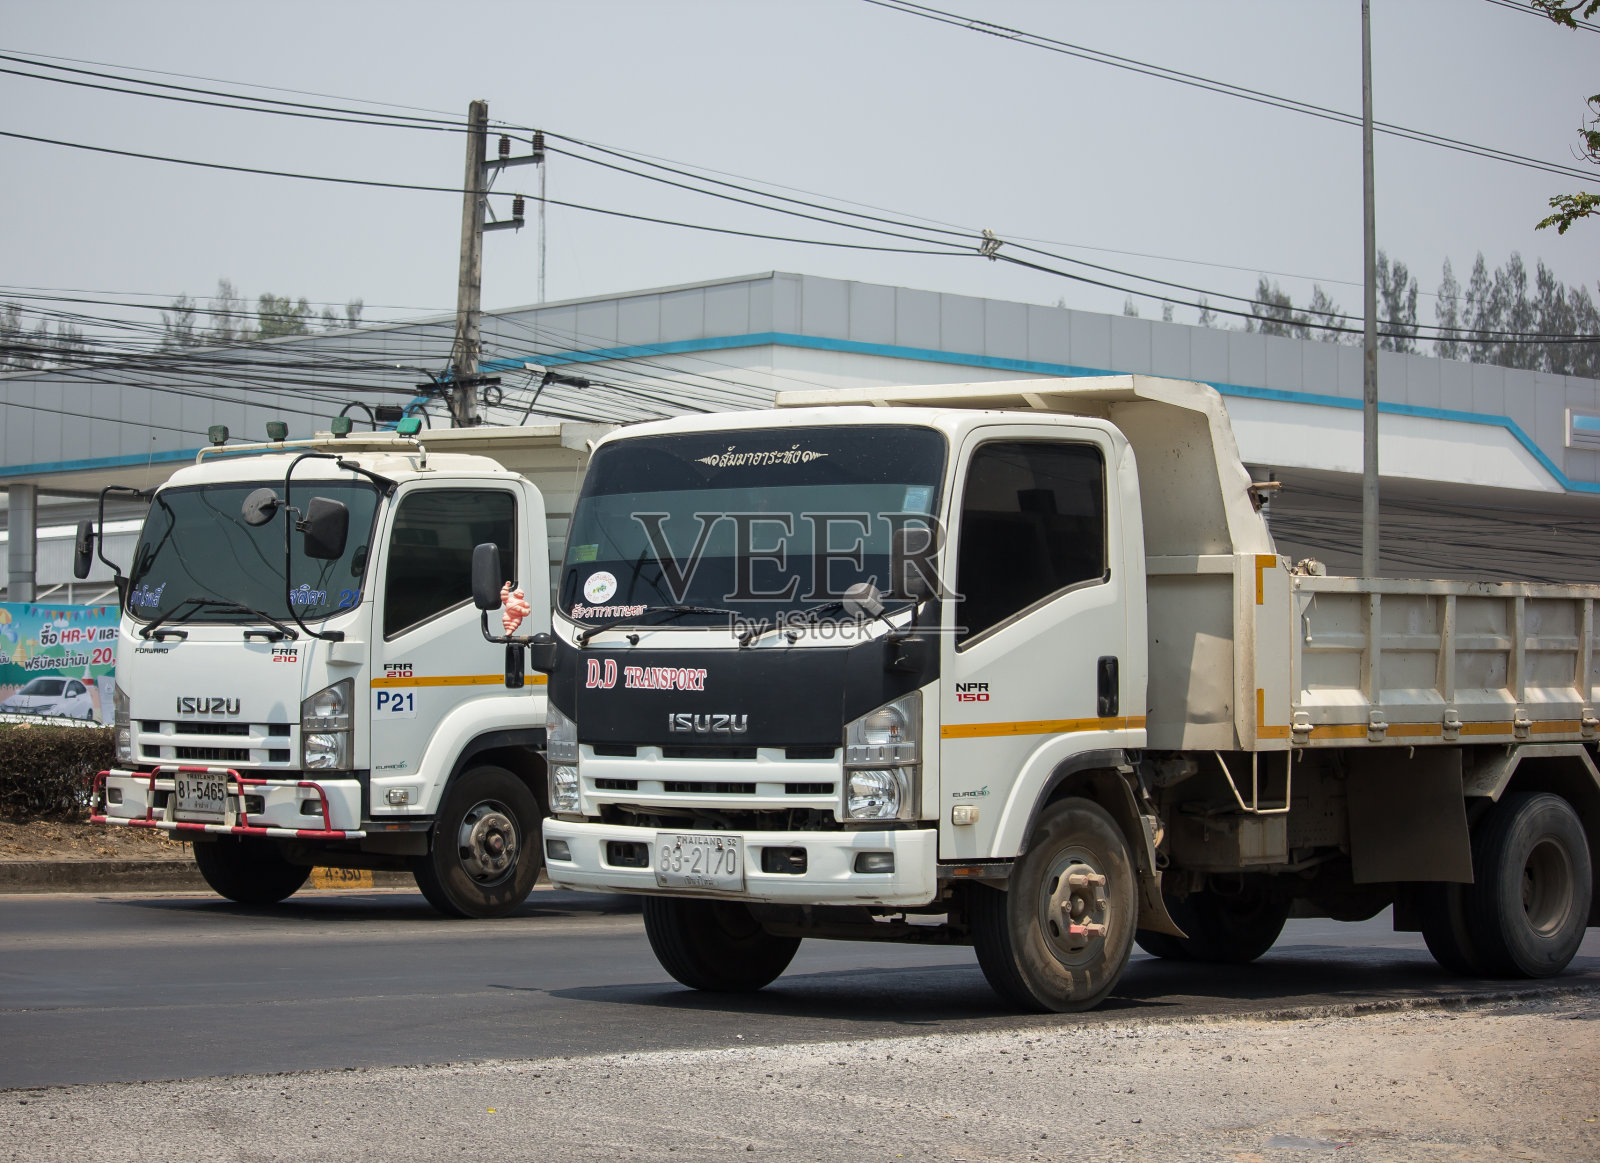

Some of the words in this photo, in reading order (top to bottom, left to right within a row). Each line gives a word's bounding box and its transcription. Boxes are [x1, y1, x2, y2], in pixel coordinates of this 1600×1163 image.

[340, 589, 361, 608] 21
[41, 624, 58, 646] ซื้อ
[60, 628, 96, 643] HR-V
[25, 651, 89, 670] ฟรีบัตรน้ำมัน
[271, 648, 298, 656] FRR
[384, 663, 413, 671] FRR
[586, 659, 617, 689] D.D
[624, 666, 707, 691] TRANSPORT
[956, 683, 989, 692] NPR
[176, 697, 241, 715] ISUZU
[377, 691, 413, 712] P21
[956, 693, 990, 702] 150
[668, 713, 748, 733] ISUZU
[178, 780, 225, 801] 81-5465
[677, 836, 722, 846] THAILAND
[727, 838, 737, 847] 52
[660, 845, 736, 875] 83-2170
